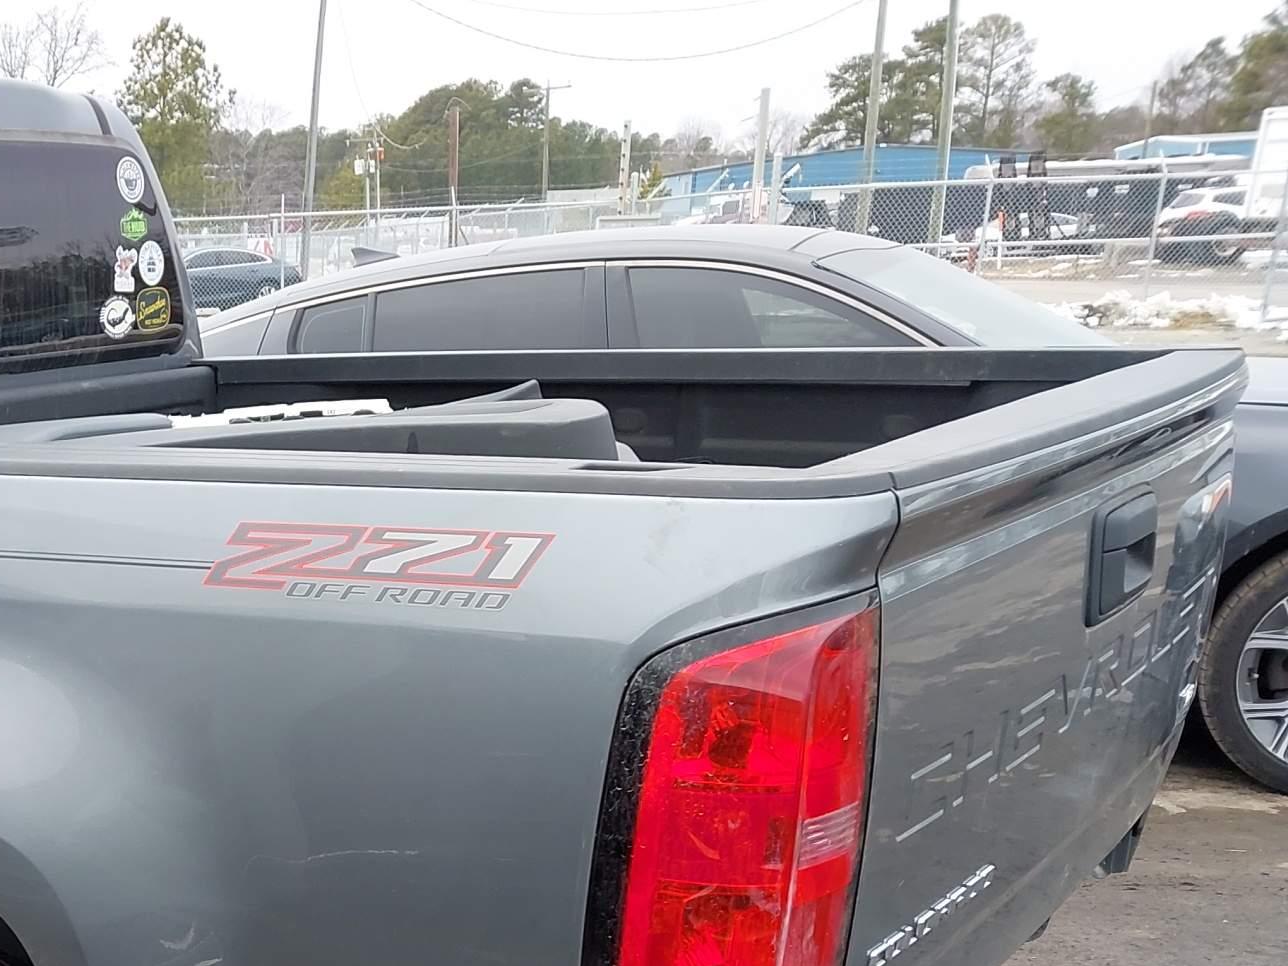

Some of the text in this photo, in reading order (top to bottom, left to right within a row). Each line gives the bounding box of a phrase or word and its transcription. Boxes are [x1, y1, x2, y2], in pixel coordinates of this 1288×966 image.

[202, 520, 557, 590] Z71
[285, 581, 512, 611] OFF ROAD
